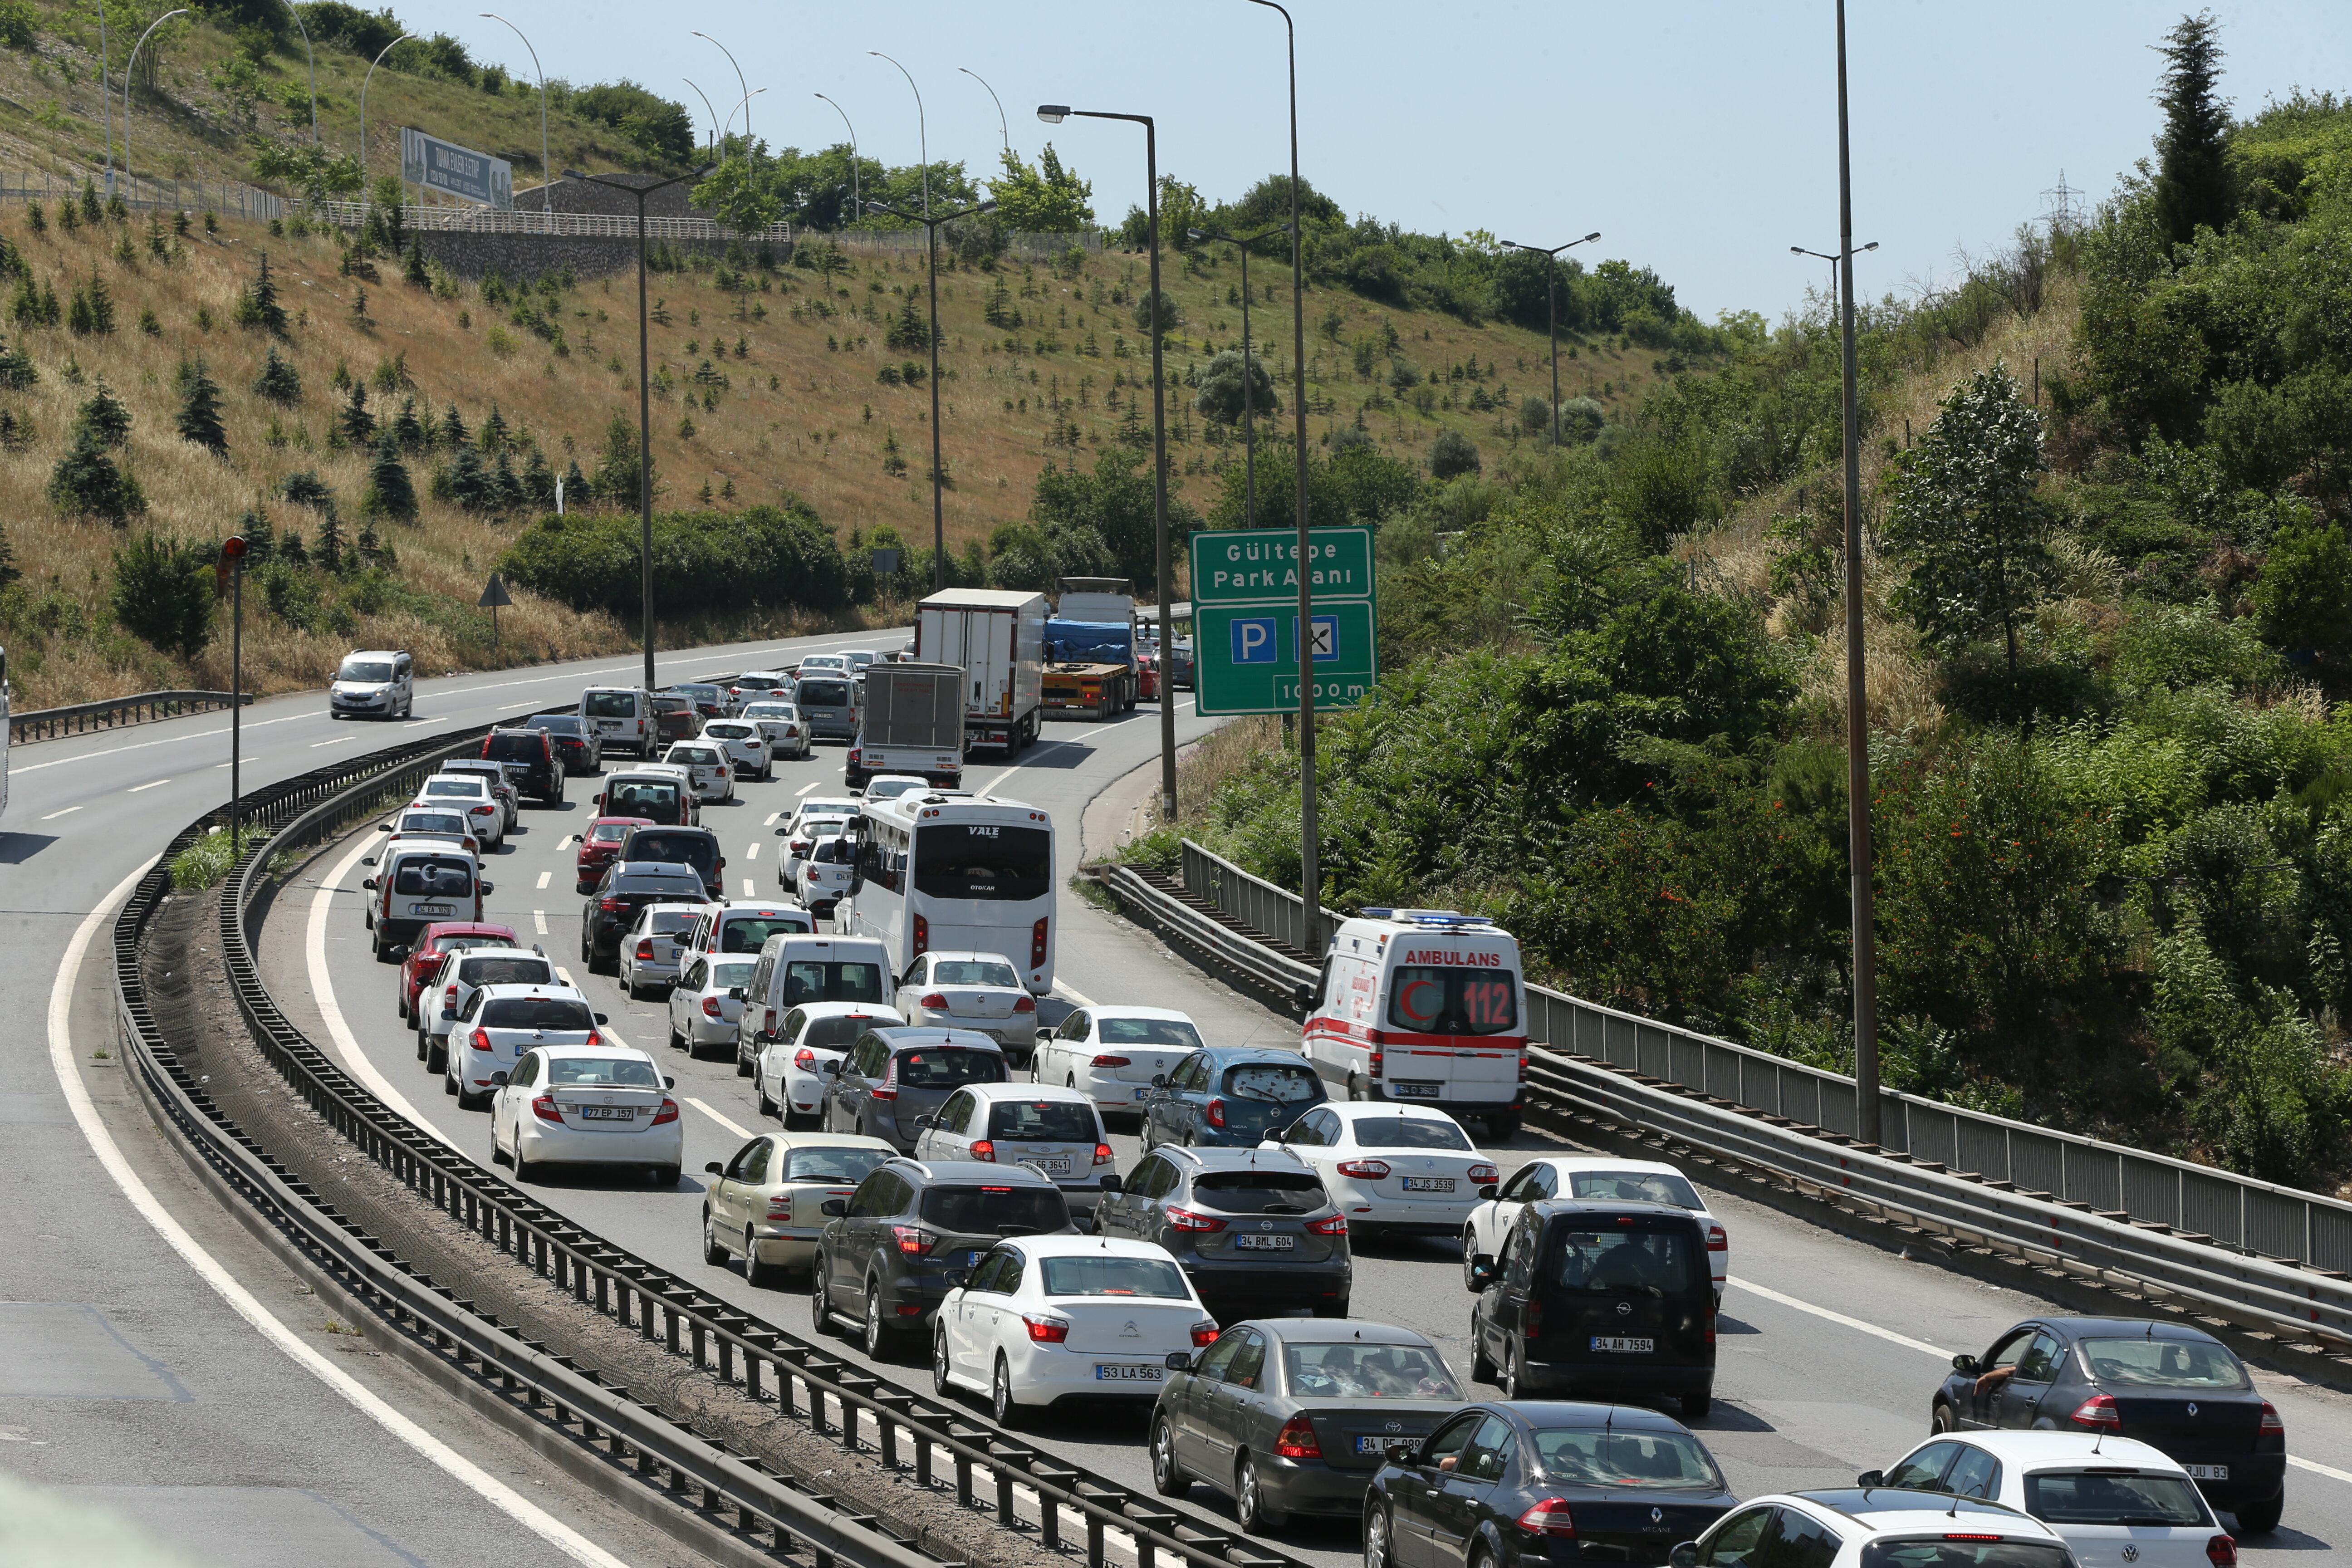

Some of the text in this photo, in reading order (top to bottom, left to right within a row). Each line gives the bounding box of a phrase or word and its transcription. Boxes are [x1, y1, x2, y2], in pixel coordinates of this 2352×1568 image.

[1227, 543, 1336, 563] Gültepe
[1214, 568, 1351, 588] Park Aanı
[1242, 623, 1266, 659] P
[1348, 685, 1364, 696] m
[968, 827, 1000, 835] VALE
[1405, 951, 1500, 966] AMBULANS
[1464, 982, 1509, 1024] 112
[588, 1108, 598, 1117] 77
[617, 1110, 631, 1118] 157
[1409, 1179, 1452, 1189] 34 JS 3539
[1242, 1236, 1291, 1246] 34 BML 604
[1597, 1338, 1651, 1350] 34 AH 7594
[1103, 1367, 1161, 1379] 53 LA 563
[1363, 1438, 1376, 1450] 34
[2186, 1465, 2226, 1478] RJU 83
